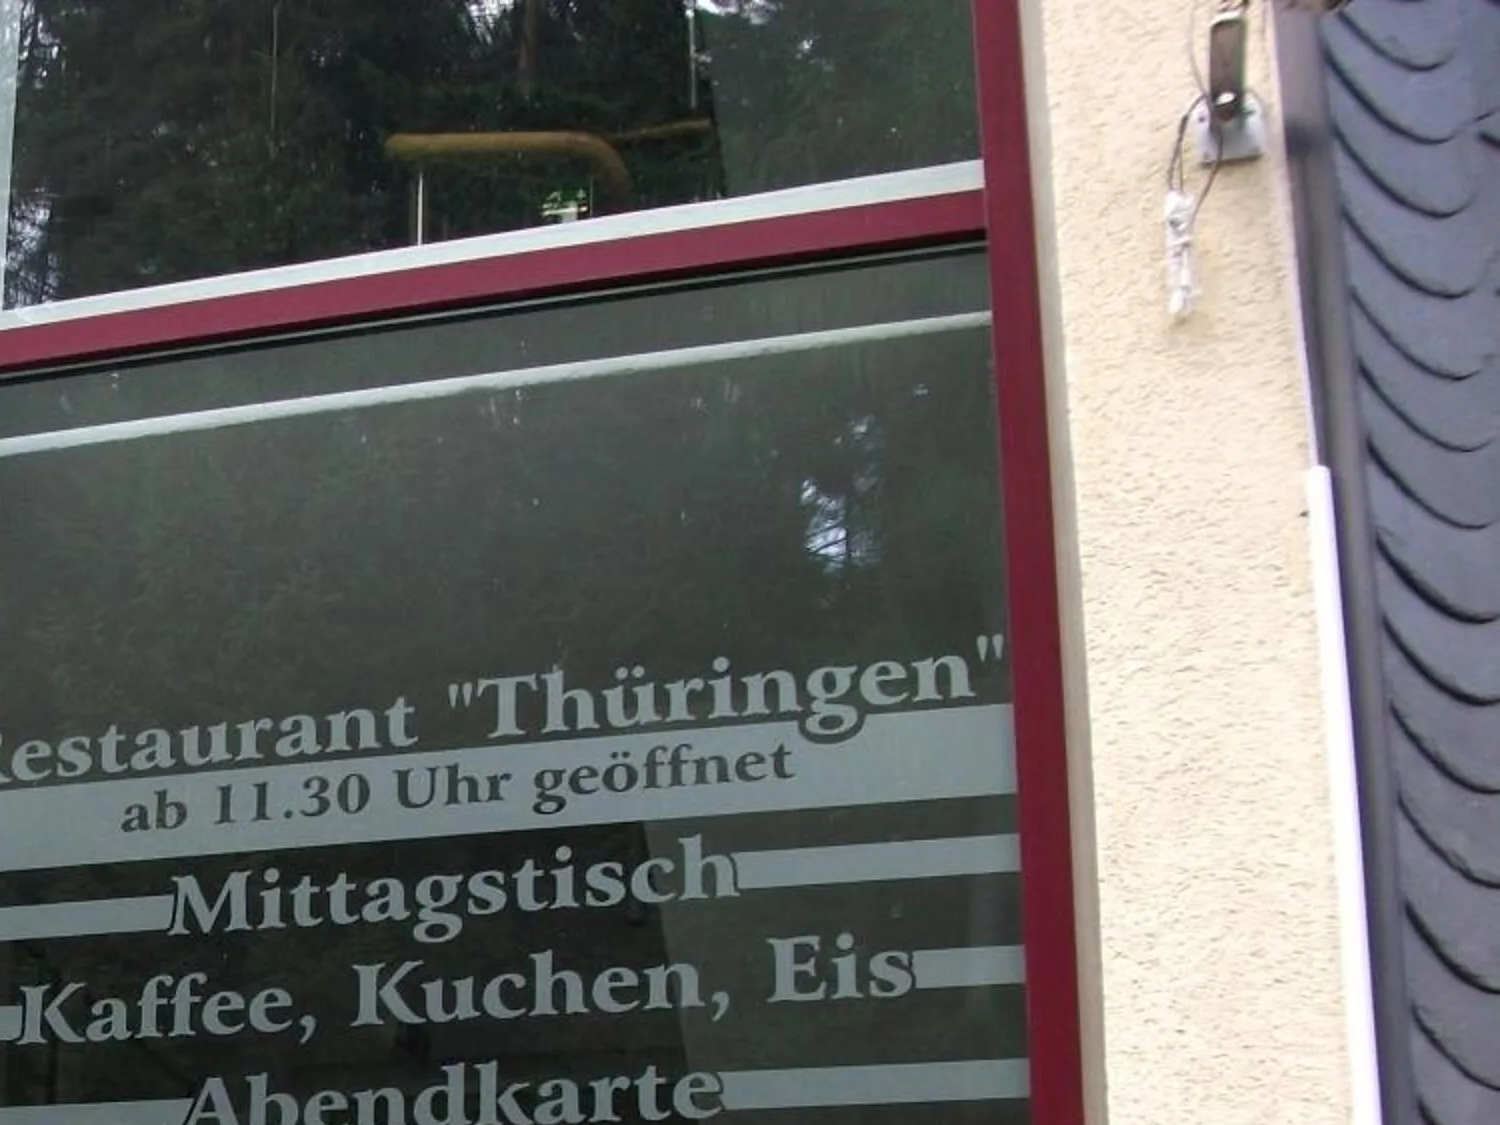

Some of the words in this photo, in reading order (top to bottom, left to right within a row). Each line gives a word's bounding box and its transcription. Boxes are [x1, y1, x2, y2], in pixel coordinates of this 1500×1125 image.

[447, 634, 1005, 739] "Thüringen"
[120, 789, 189, 833] ab
[214, 773, 371, 825] 11.30
[395, 762, 512, 809] Uhr
[532, 743, 796, 815] geöffnet
[167, 833, 740, 944] Mittagstisch
[16, 972, 317, 1045] Kaffee,
[350, 949, 730, 1027] Kuchen,
[765, 933, 916, 1002] Eis
